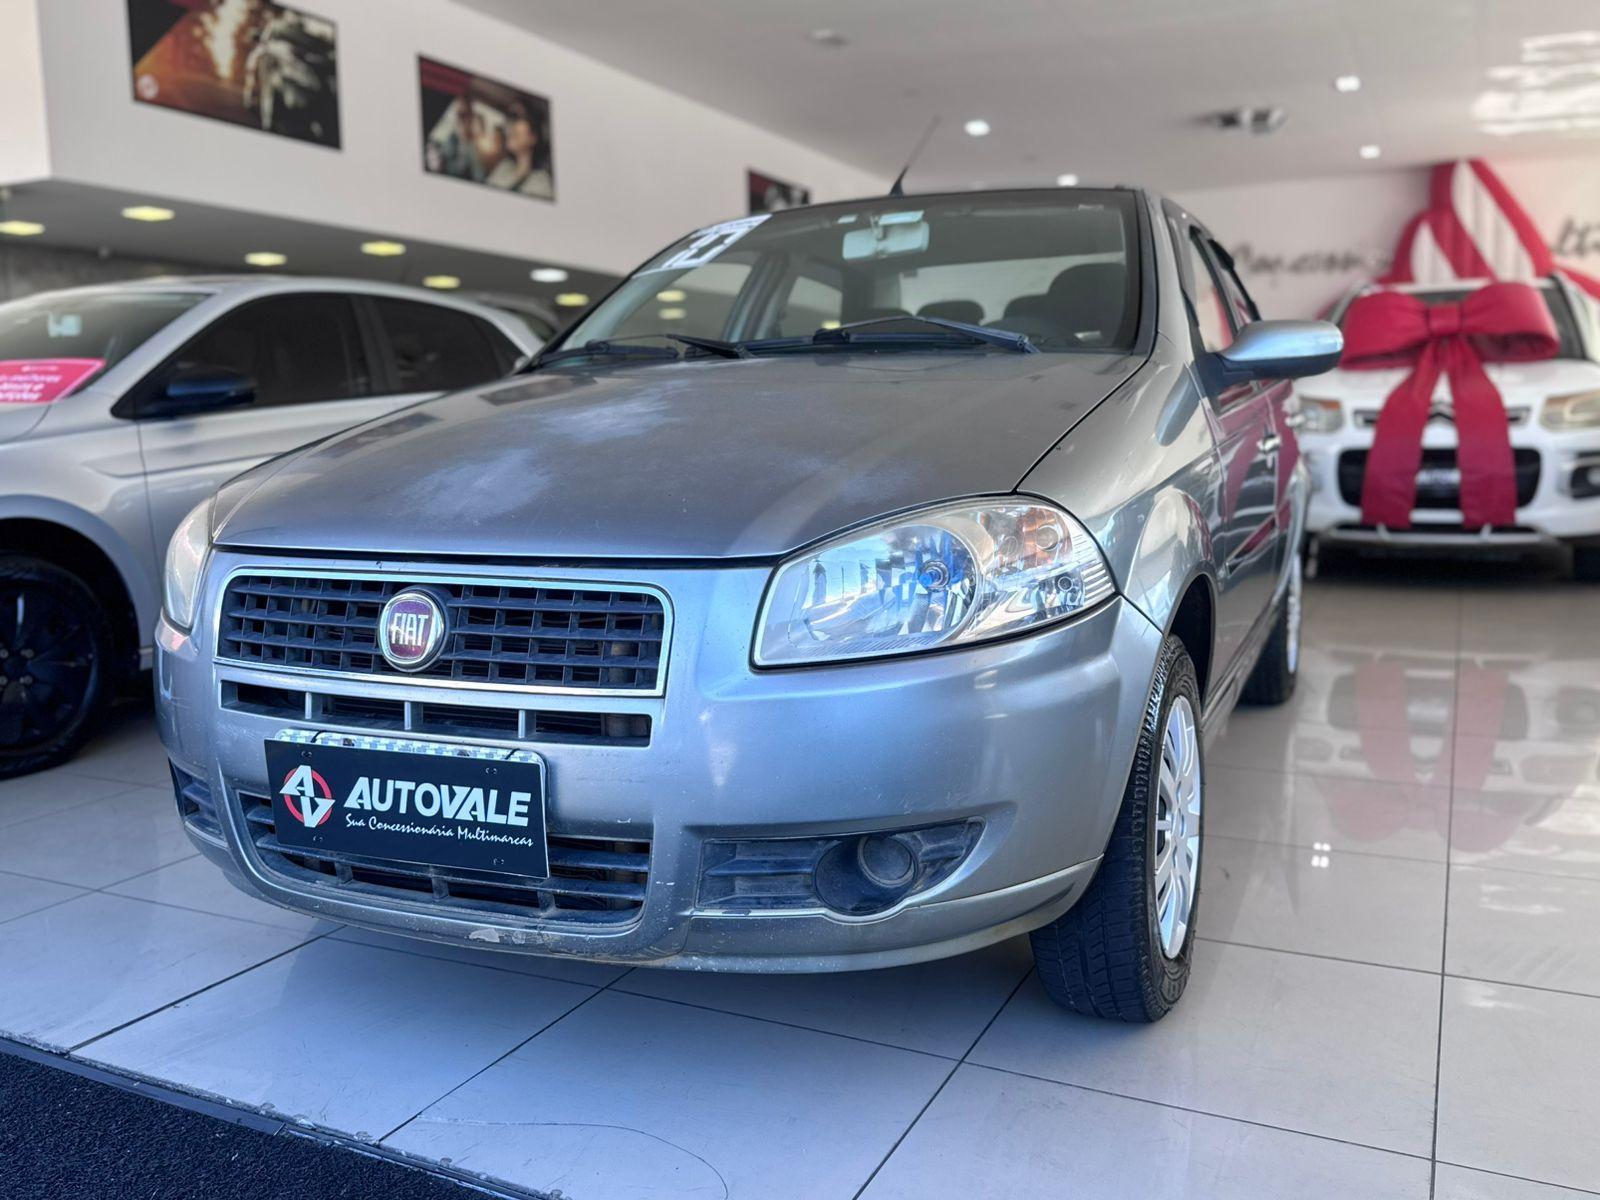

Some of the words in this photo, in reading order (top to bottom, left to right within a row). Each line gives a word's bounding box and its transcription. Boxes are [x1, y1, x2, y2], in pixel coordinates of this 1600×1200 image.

[390, 612, 429, 646] FIAT
[343, 776, 532, 827] AUTOVALE
[345, 813, 366, 828] Sua
[368, 816, 455, 837] Concessionária
[457, 825, 534, 847] Multimarcas
